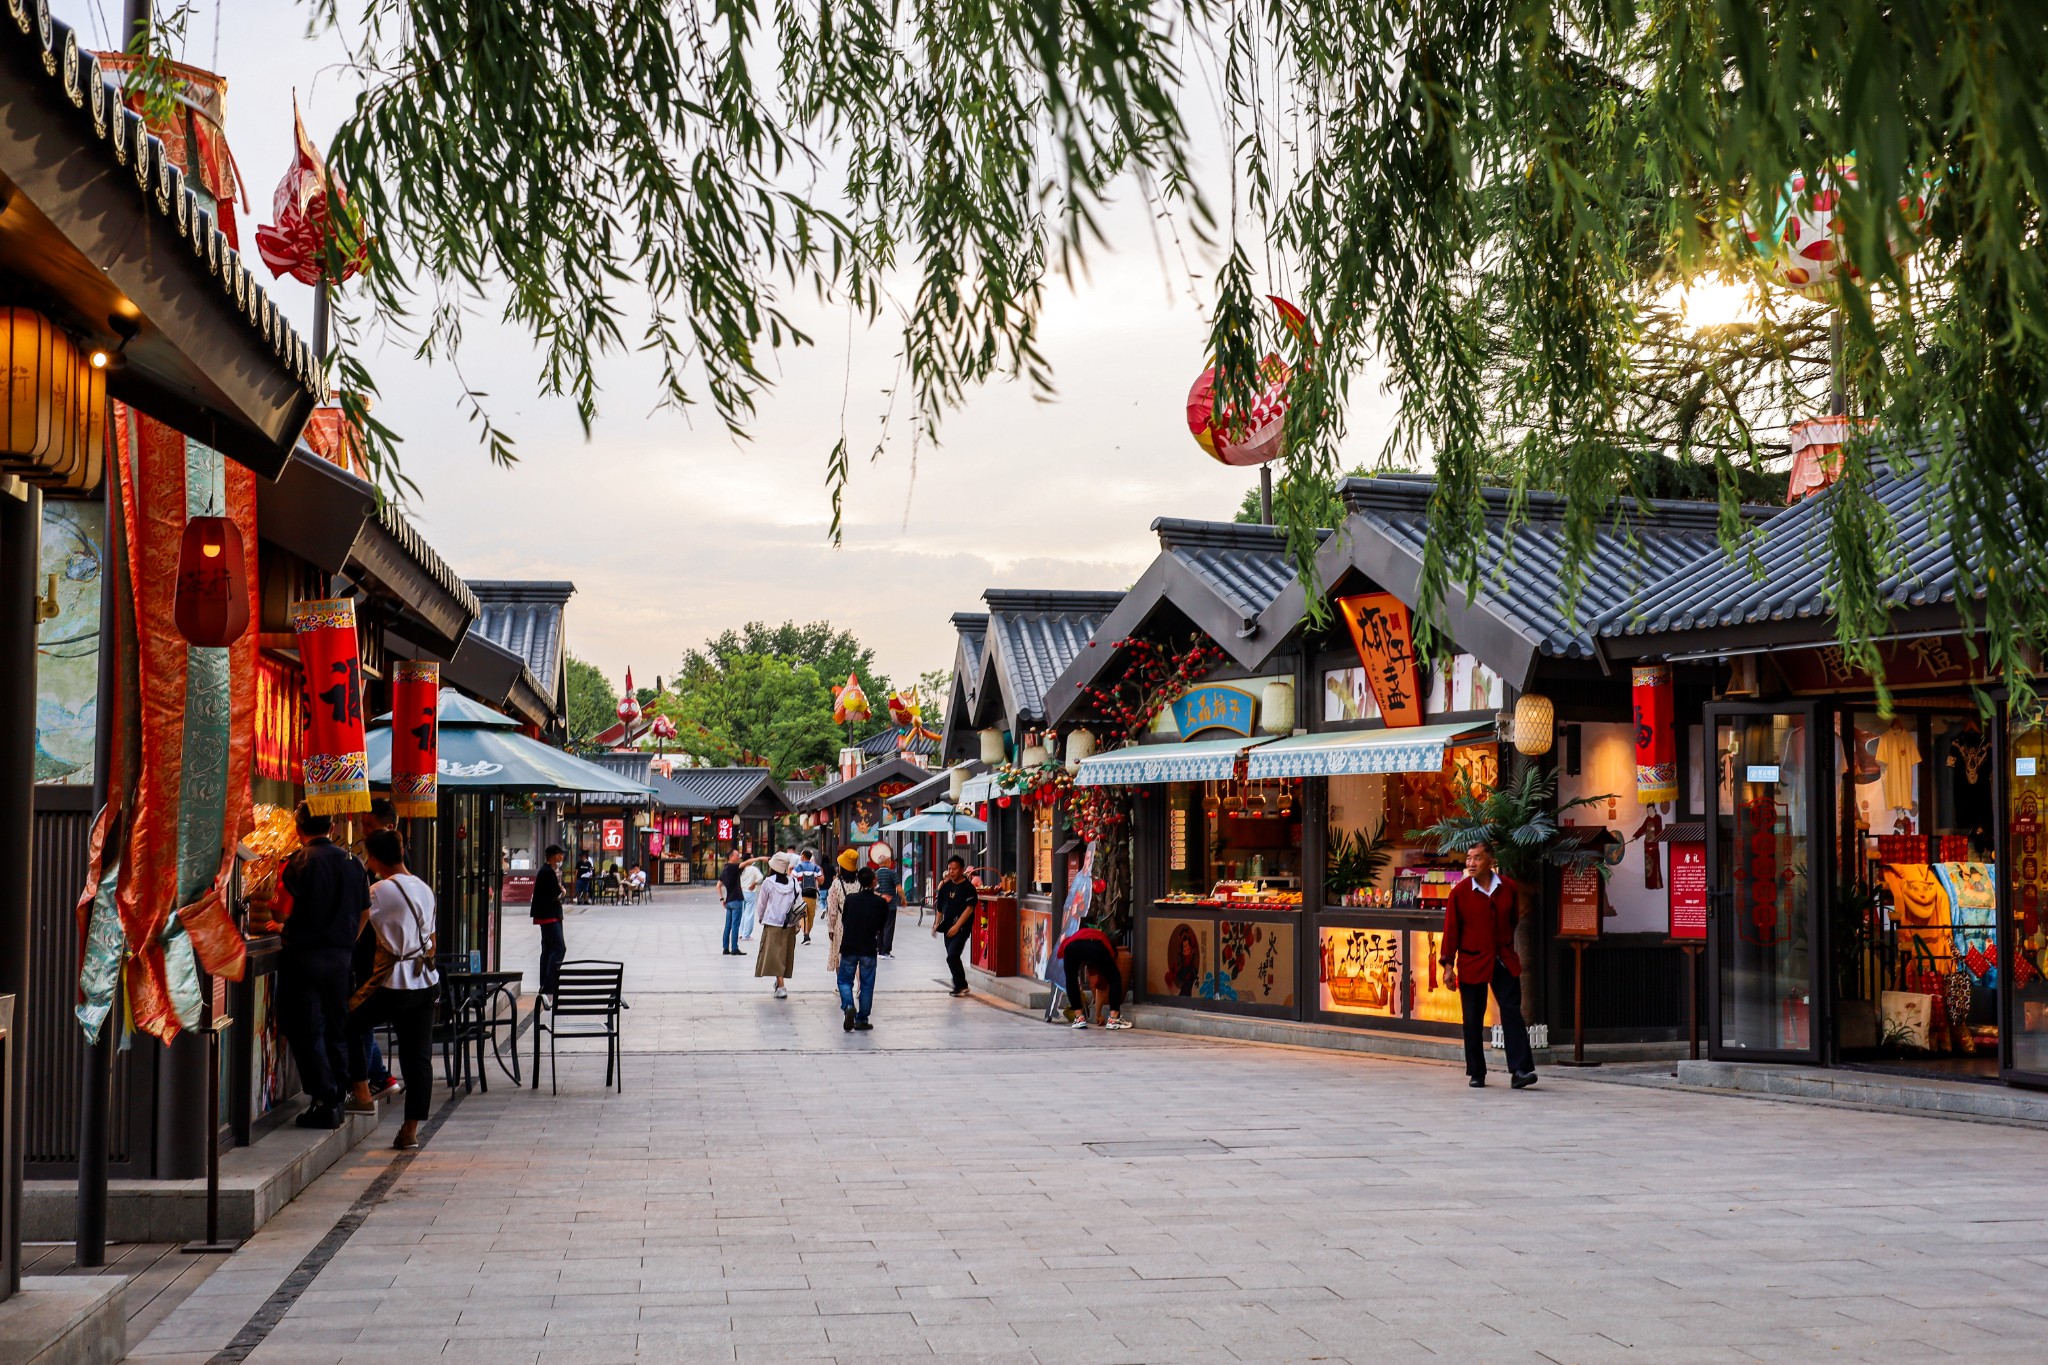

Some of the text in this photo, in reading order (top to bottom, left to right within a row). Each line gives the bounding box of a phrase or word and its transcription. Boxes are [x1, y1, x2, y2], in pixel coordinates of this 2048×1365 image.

[1357, 607, 1411, 711] 椰子盏
[1184, 692, 1241, 728] 火晶柿子
[605, 829, 621, 847] 面
[1345, 930, 1403, 973] 椰子盏
